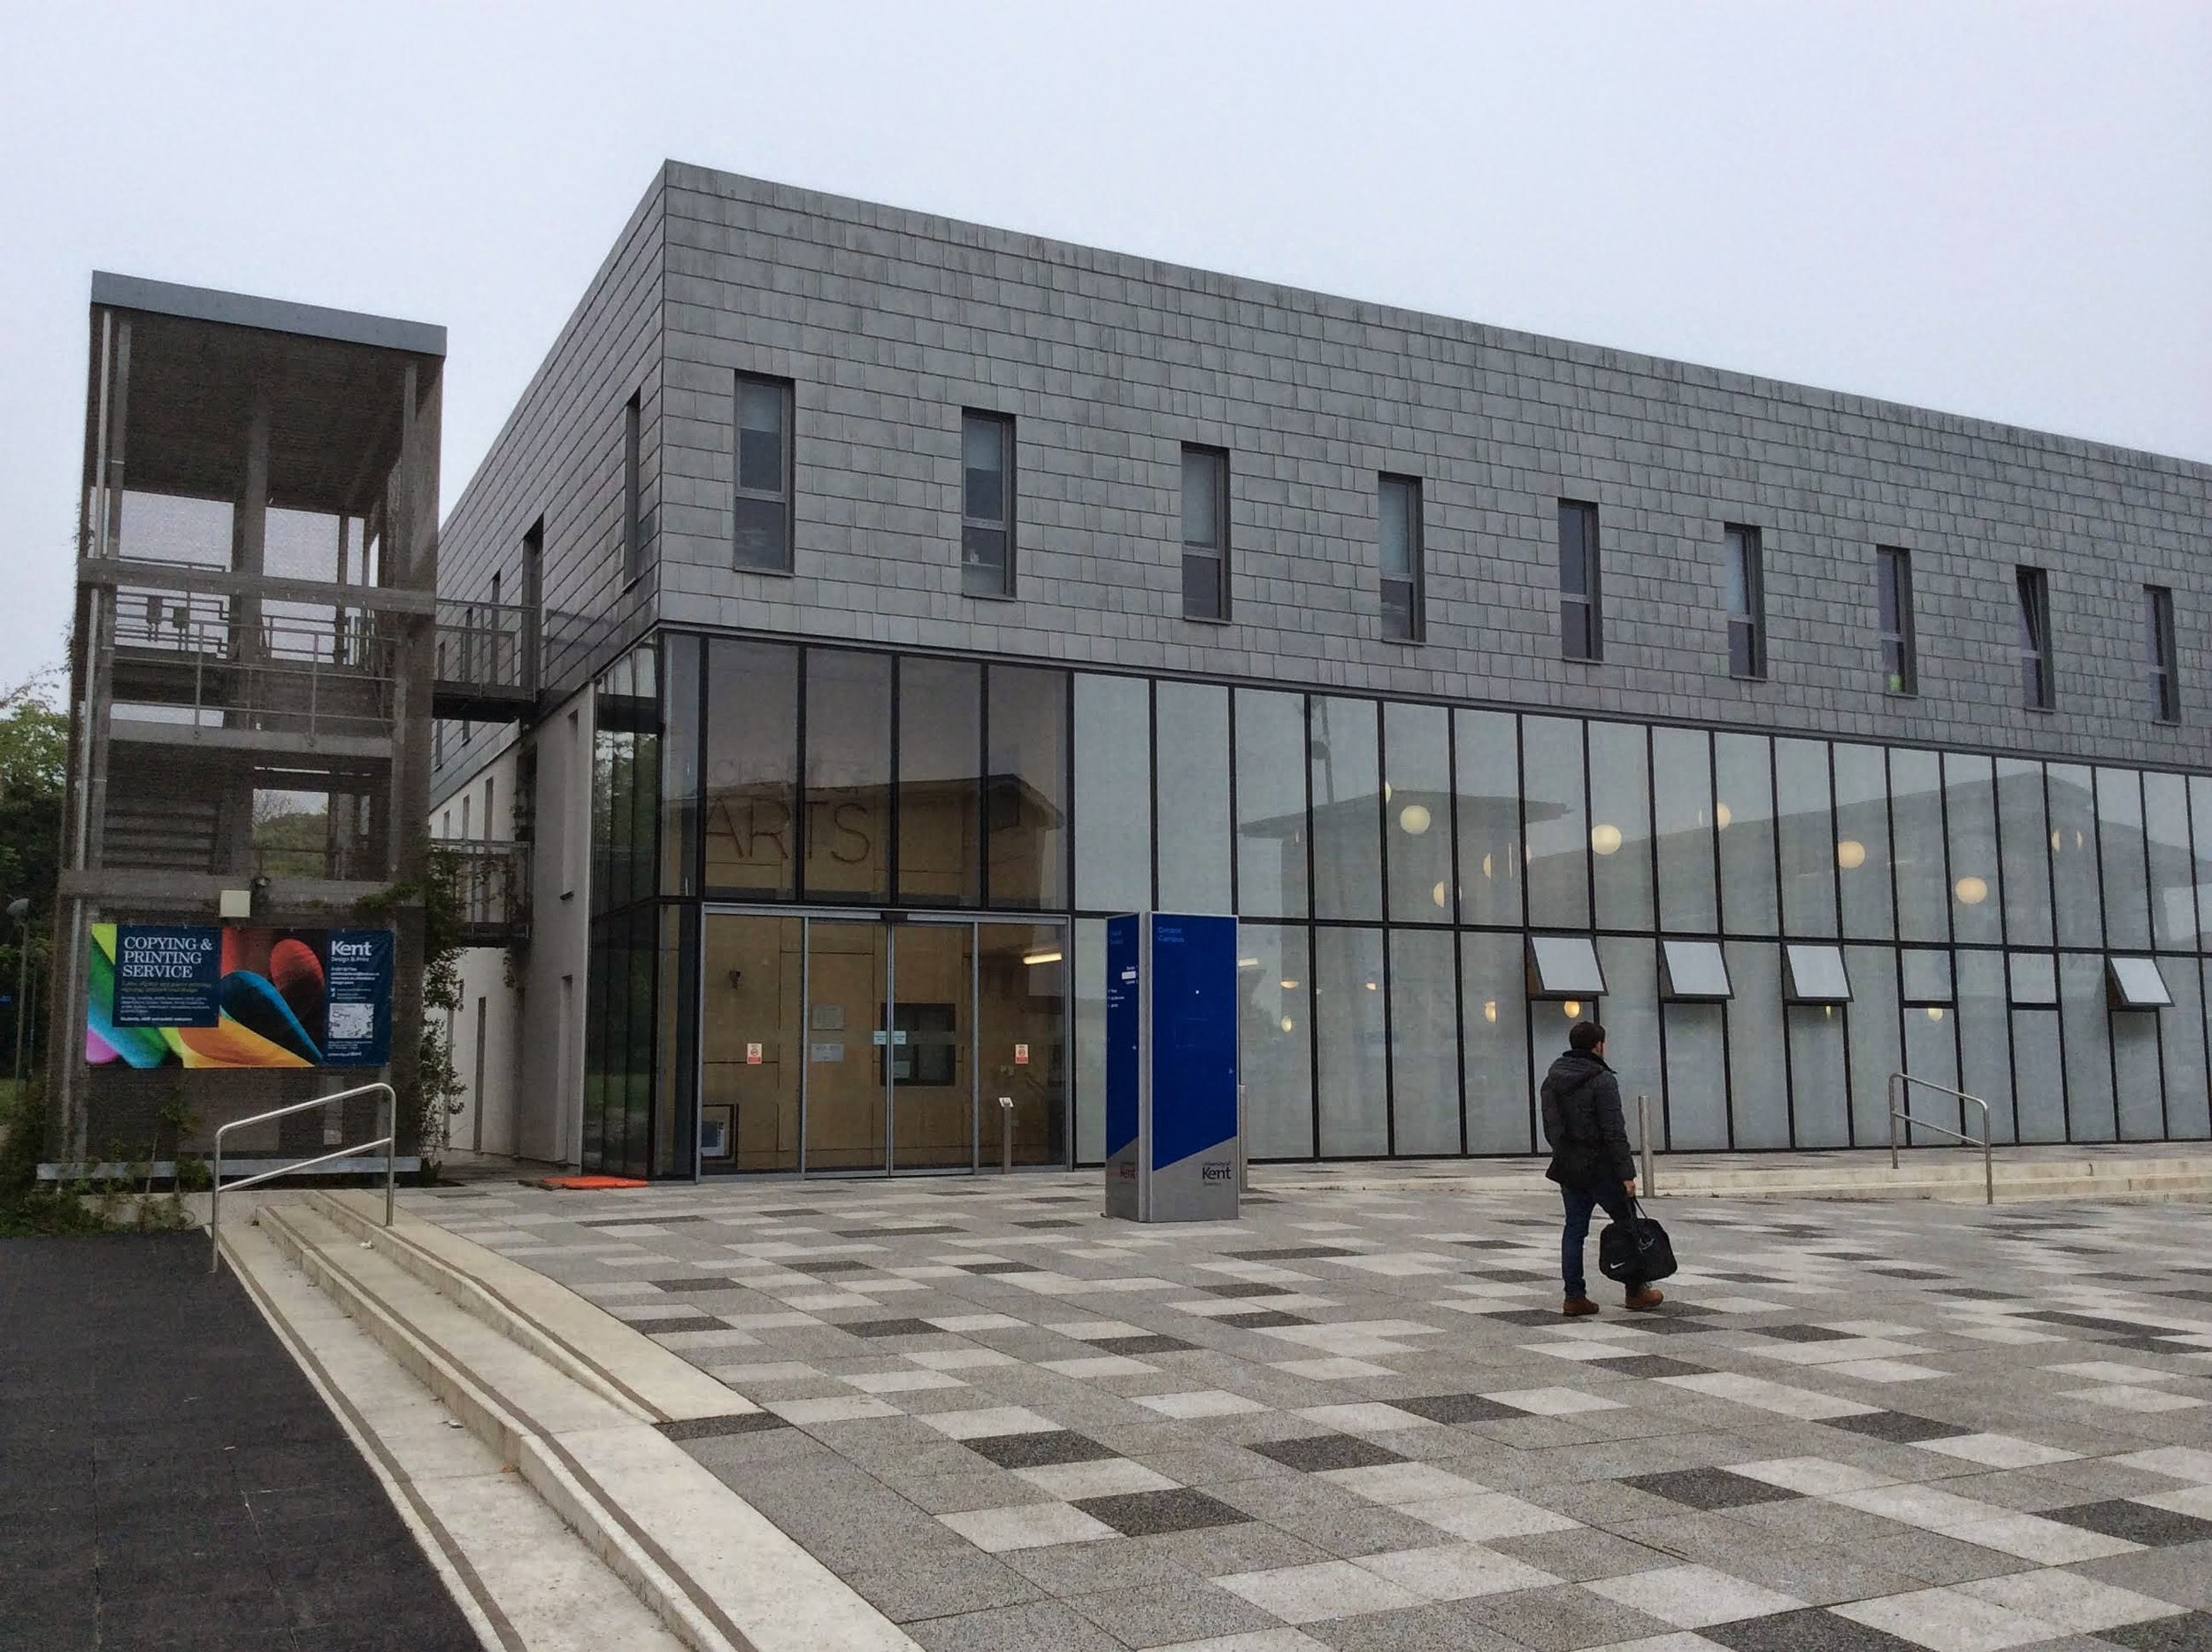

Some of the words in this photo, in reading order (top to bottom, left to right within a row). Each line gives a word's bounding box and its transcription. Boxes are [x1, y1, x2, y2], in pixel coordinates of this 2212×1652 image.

[707, 796, 871, 863] ARTS
[124, 936, 196, 950] COPYING
[200, 938, 213, 950] &
[331, 941, 373, 956] Kent
[123, 950, 203, 964] PRINTING
[122, 964, 193, 978] SERVICE
[1202, 1166, 1232, 1179] Kent
